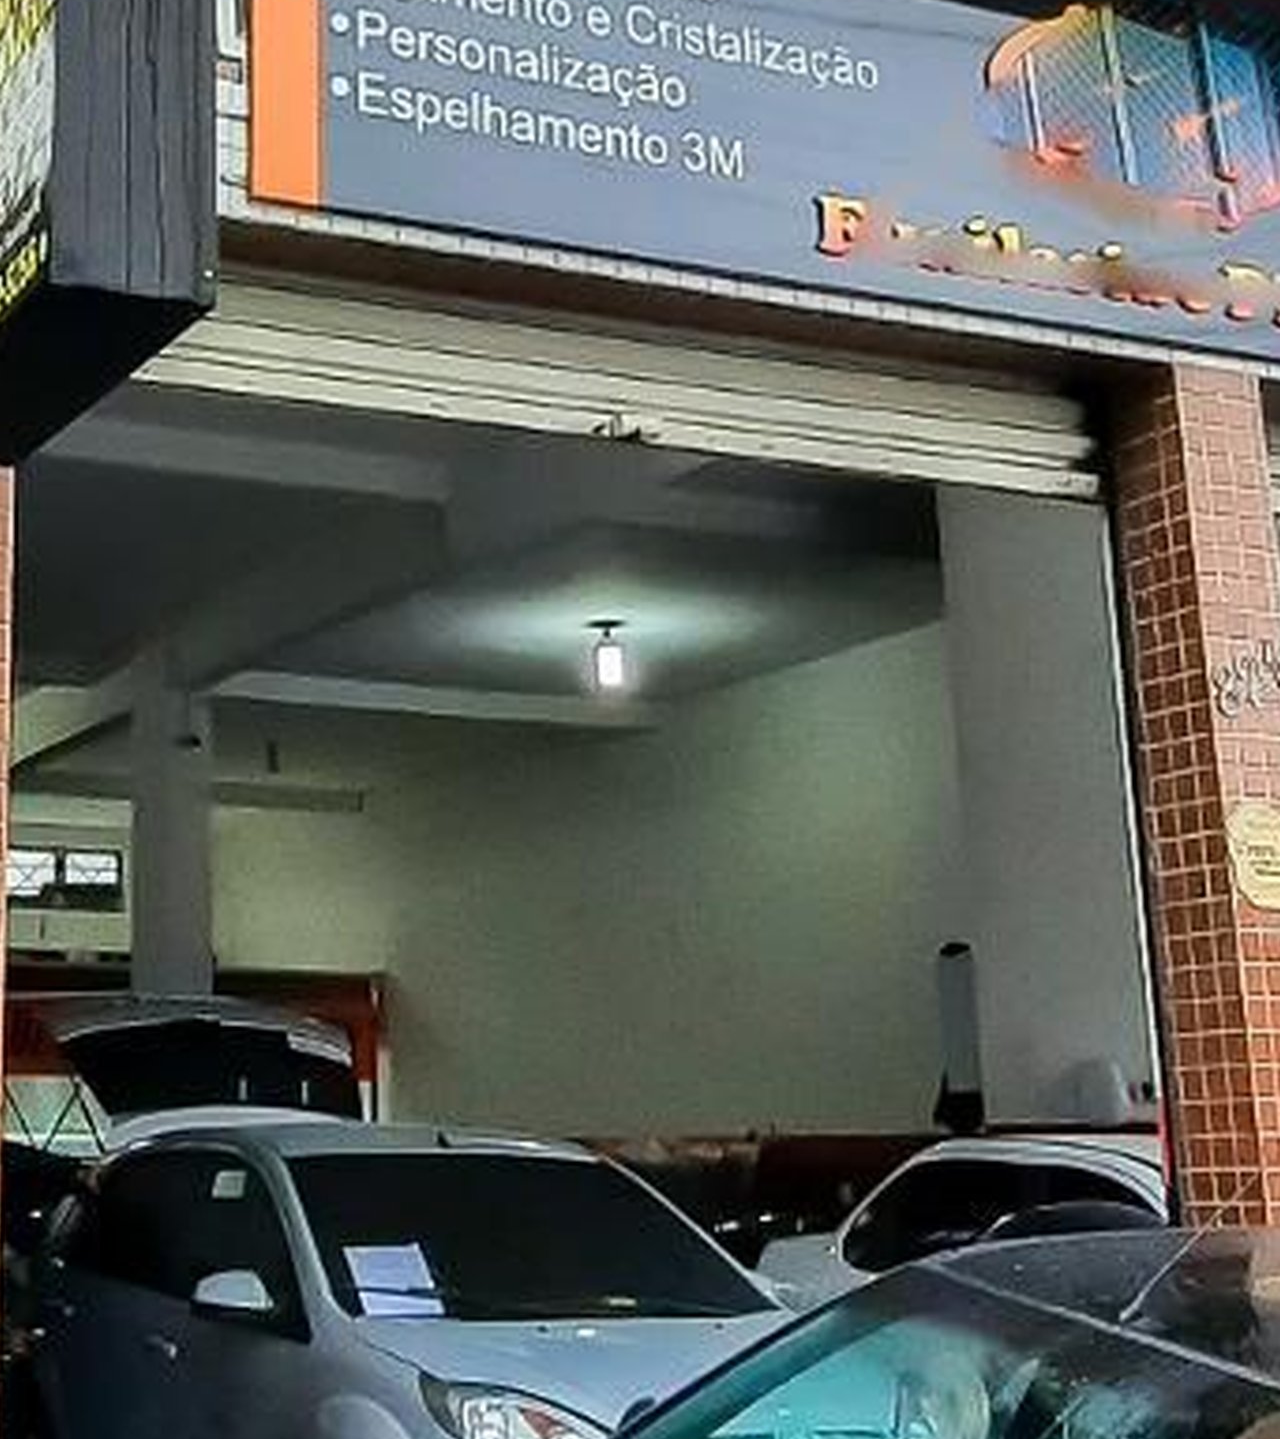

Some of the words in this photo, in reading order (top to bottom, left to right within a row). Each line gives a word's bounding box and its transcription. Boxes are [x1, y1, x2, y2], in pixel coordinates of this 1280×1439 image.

[356, 9, 688, 108] Personalização
[586, 4, 613, 37] e
[625, 4, 879, 90] Cristalização
[356, 71, 669, 164] Espelhamento
[682, 131, 745, 179] 3M
